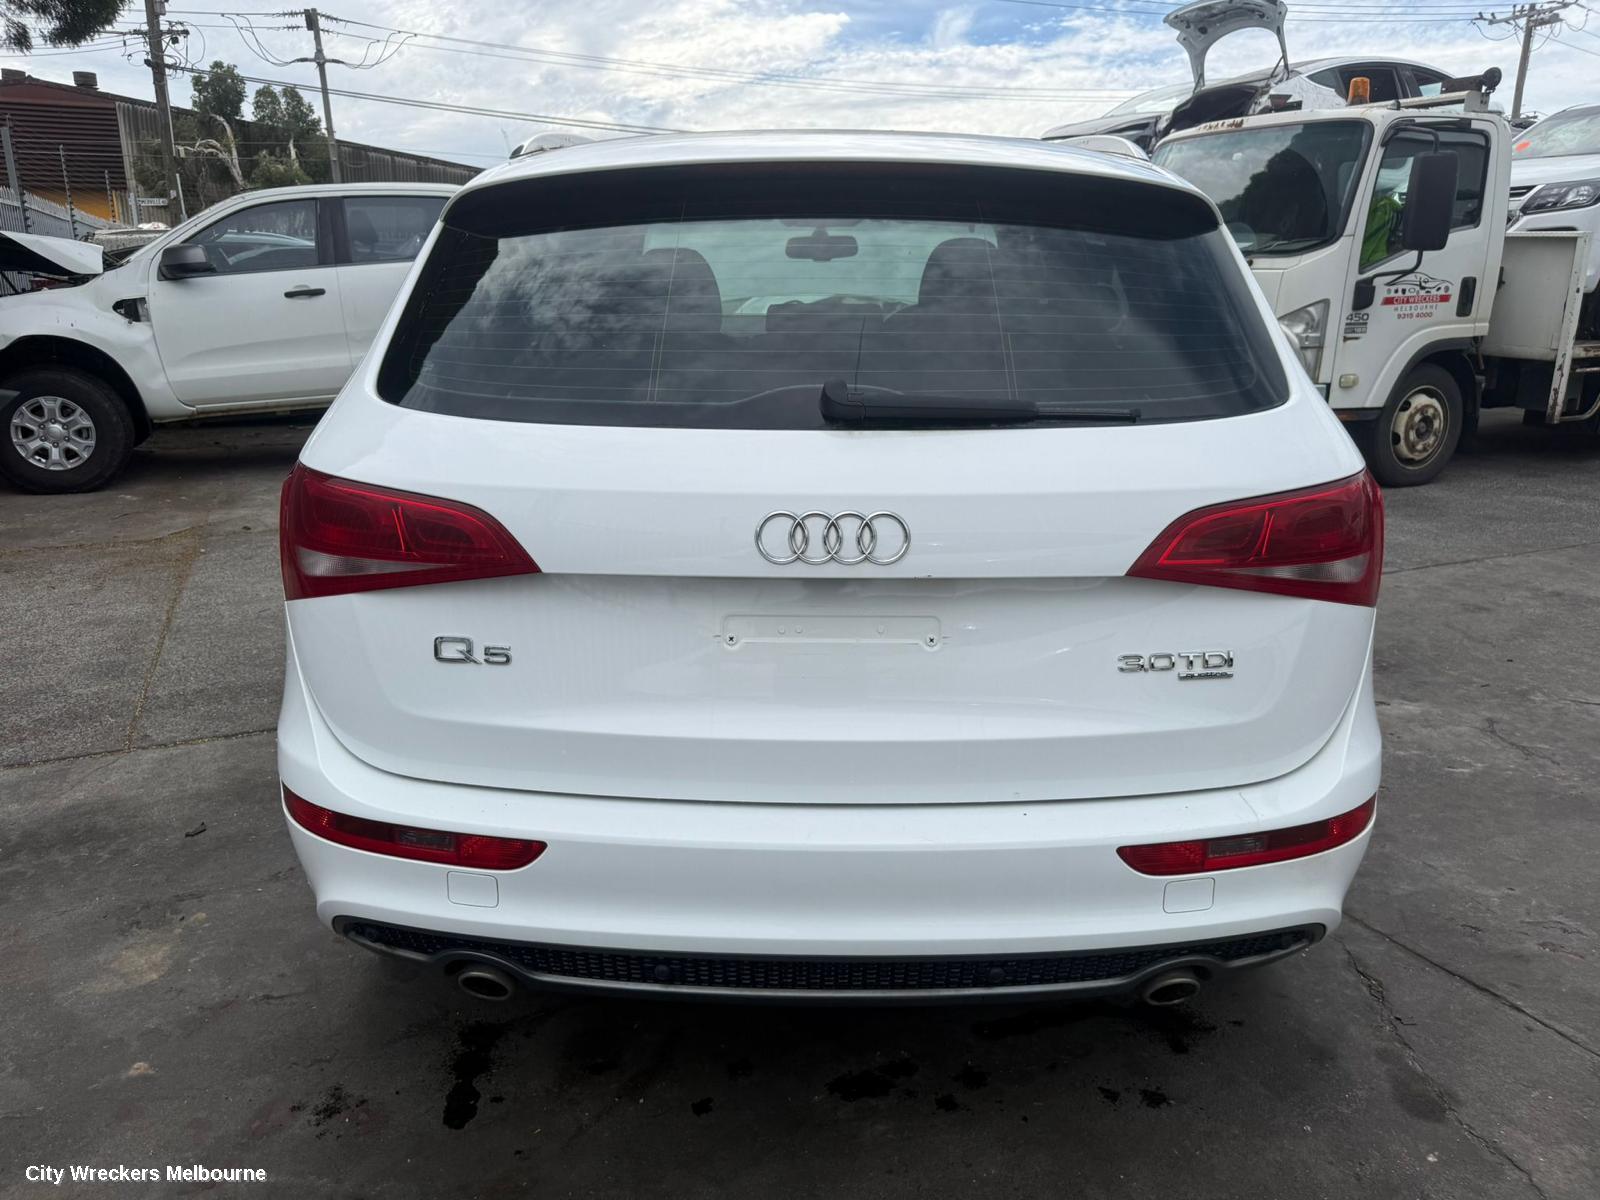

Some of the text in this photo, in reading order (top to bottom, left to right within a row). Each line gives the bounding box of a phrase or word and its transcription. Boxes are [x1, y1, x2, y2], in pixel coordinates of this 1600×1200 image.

[1393, 295, 1440, 305] CITY WRECKERS
[1346, 312, 1370, 321] 450
[434, 636, 512, 665] Q5
